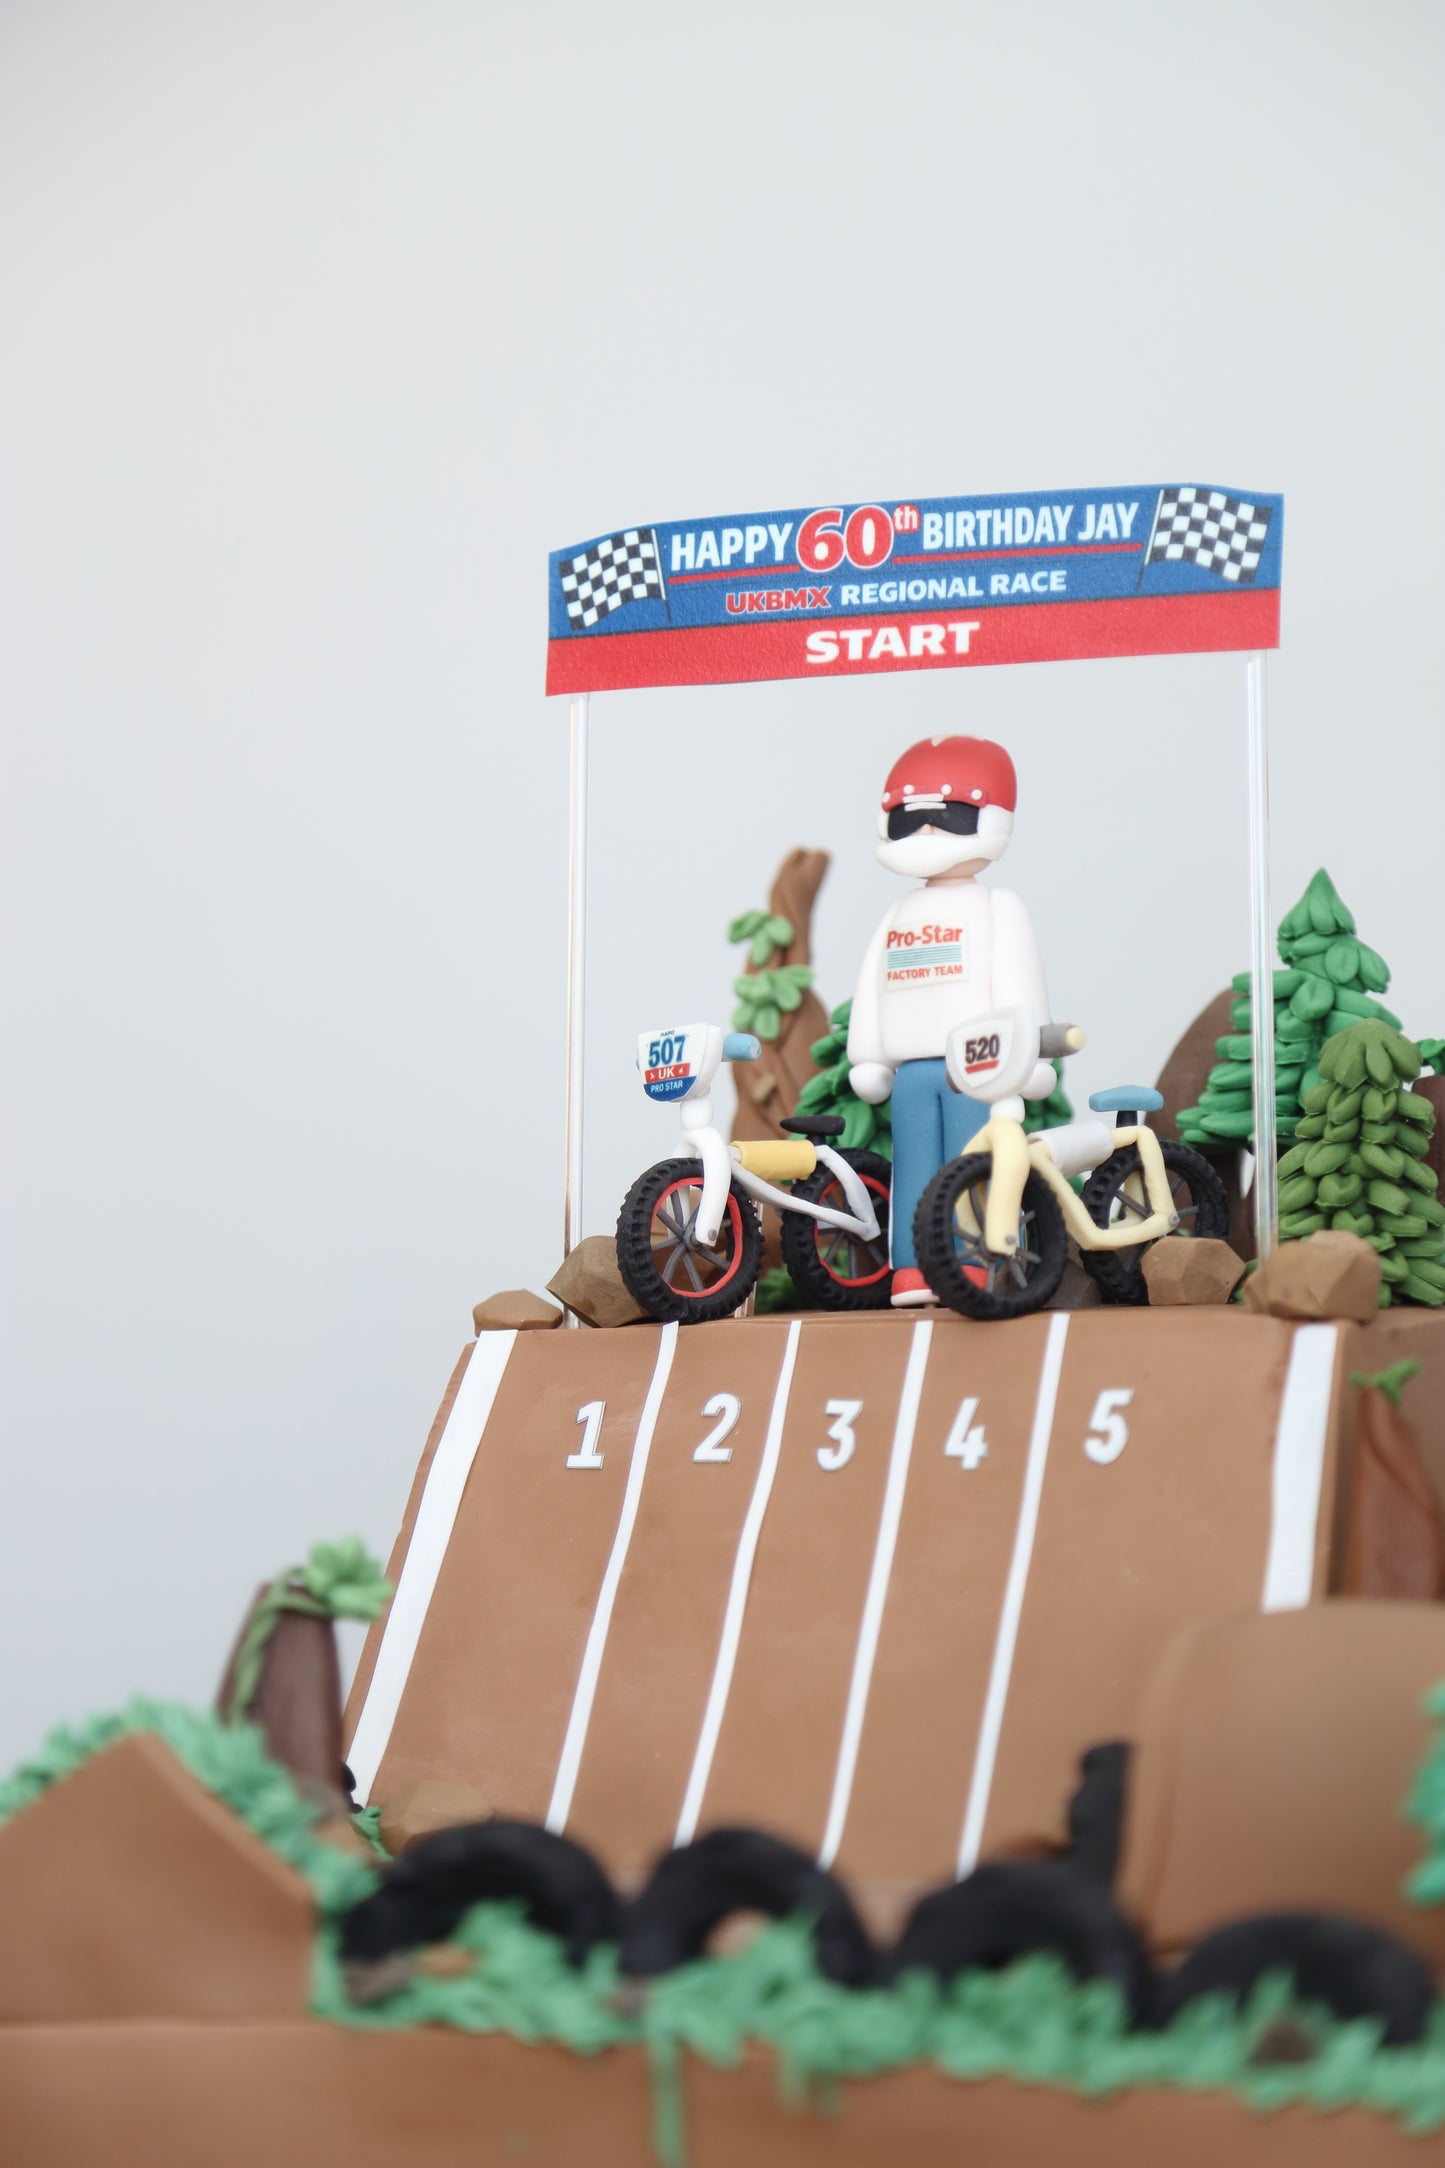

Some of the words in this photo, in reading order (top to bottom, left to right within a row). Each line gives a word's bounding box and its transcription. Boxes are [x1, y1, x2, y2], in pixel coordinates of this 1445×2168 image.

[671, 522, 793, 571] HAPPY
[922, 505, 1074, 550] BIRTHDAY
[1078, 502, 1140, 541] JAY
[725, 586, 832, 615] UKBMX
[841, 576, 983, 606] REGIONAL
[990, 570, 1068, 595] RACE
[806, 621, 980, 664] START
[886, 924, 963, 949] Pro-Star
[887, 968, 931, 982] FACTORY
[934, 964, 963, 976] TEAM
[648, 1035, 686, 1068] 507
[964, 1033, 1000, 1064] 520
[650, 1083, 664, 1093] PRO
[665, 1080, 684, 1091] STAR
[658, 1066, 675, 1079] UK
[565, 1401, 606, 1470] 1
[692, 1392, 740, 1463] 2
[816, 1399, 863, 1472] 3
[943, 1397, 989, 1470] 4
[1083, 1389, 1134, 1466] 5
